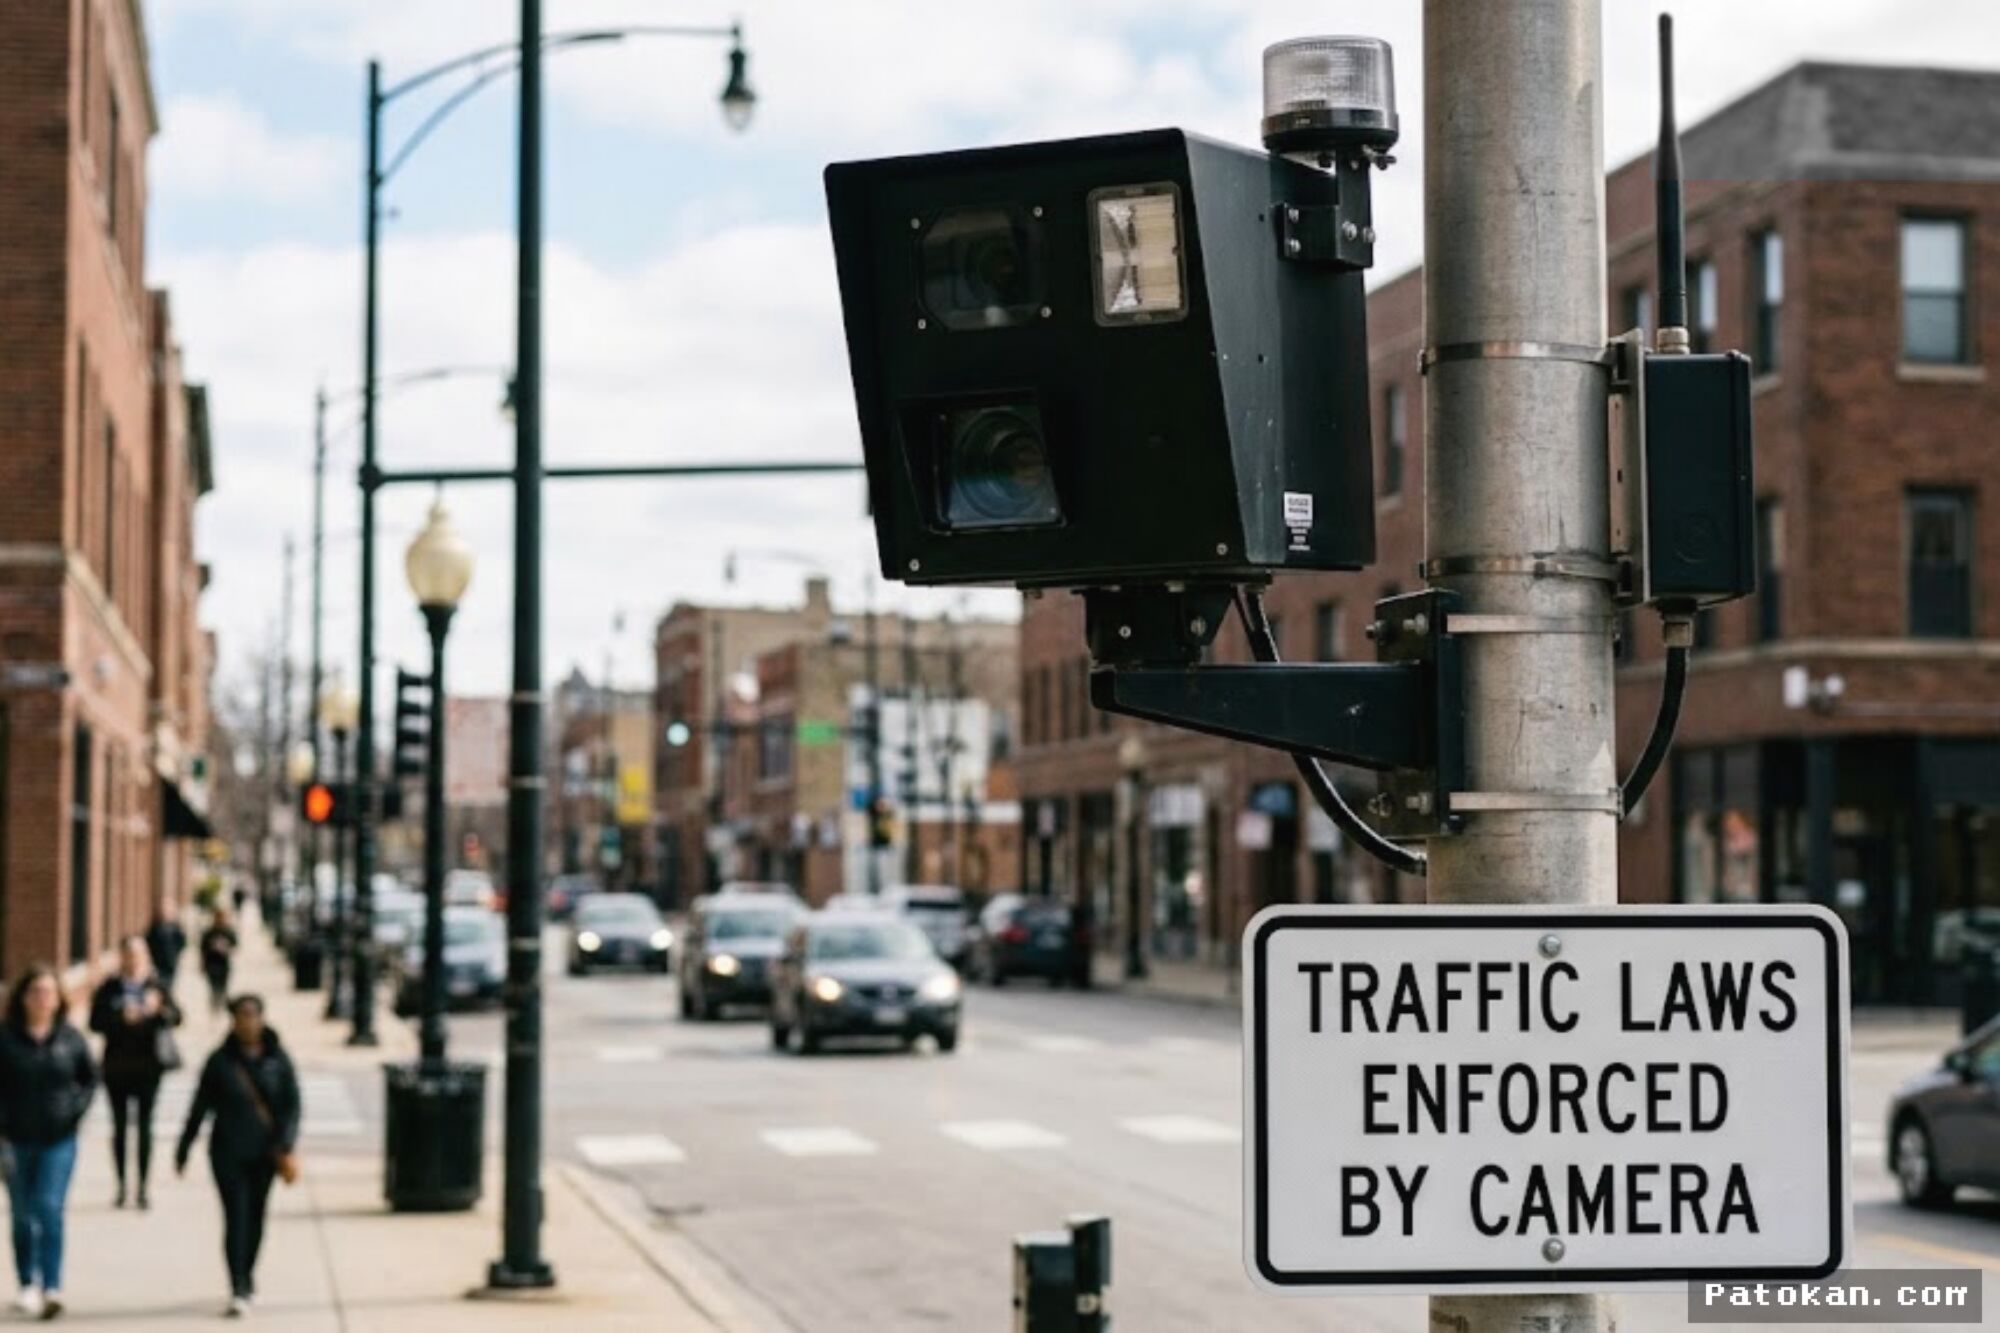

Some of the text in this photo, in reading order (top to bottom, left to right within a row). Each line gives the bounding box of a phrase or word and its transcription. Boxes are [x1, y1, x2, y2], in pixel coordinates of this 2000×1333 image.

[1297, 960, 1797, 1034] TRAFFIC LAWS
[1363, 1062, 1729, 1135] ENFORCED
[1340, 1162, 1760, 1237] BY CAMERA
